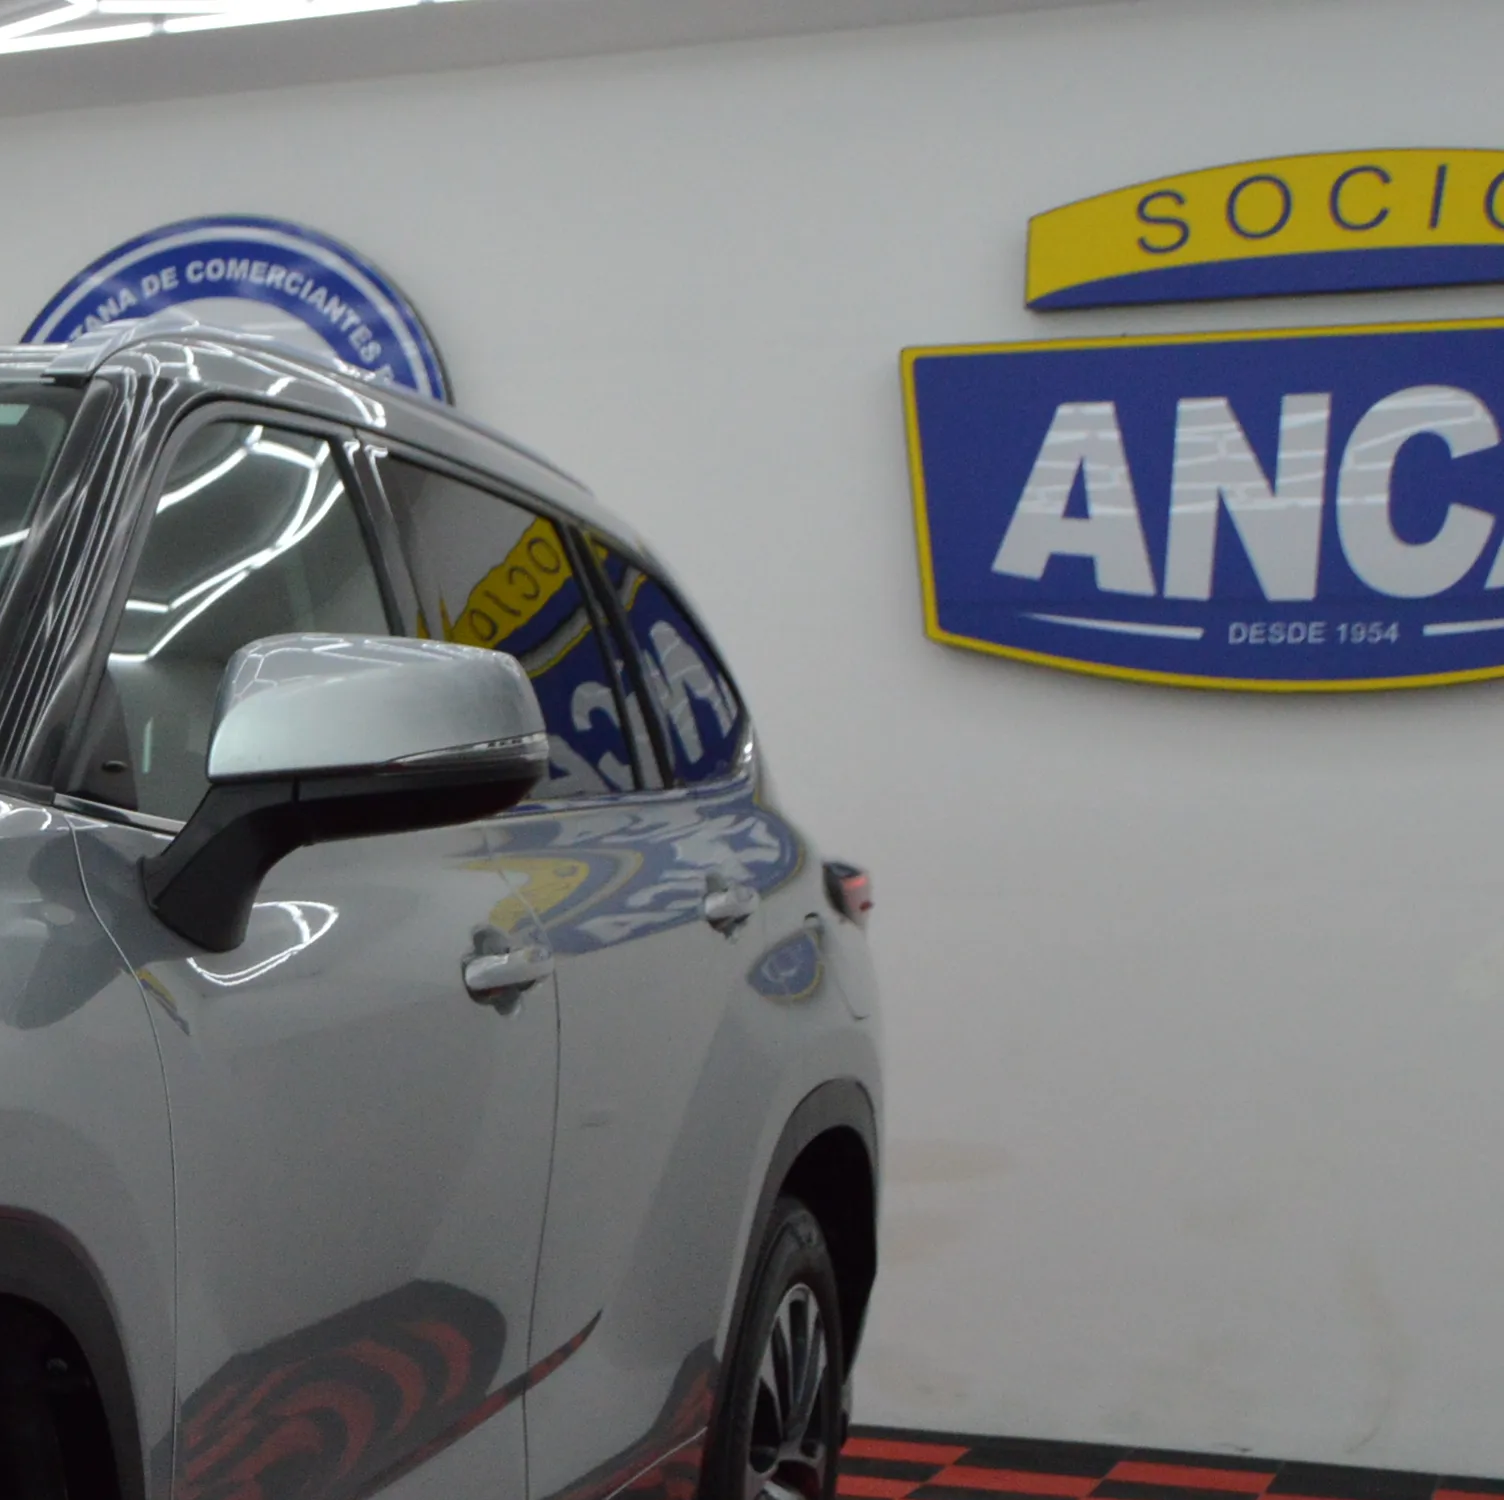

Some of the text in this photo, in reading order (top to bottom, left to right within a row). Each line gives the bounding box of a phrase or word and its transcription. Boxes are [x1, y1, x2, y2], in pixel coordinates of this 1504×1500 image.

[1135, 163, 1504, 255] SOCI
[141, 266, 180, 300] DE
[185, 258, 383, 365] COMERCIANTES
[991, 383, 1504, 603] ANC
[1227, 621, 1400, 645] DESDE 1954
